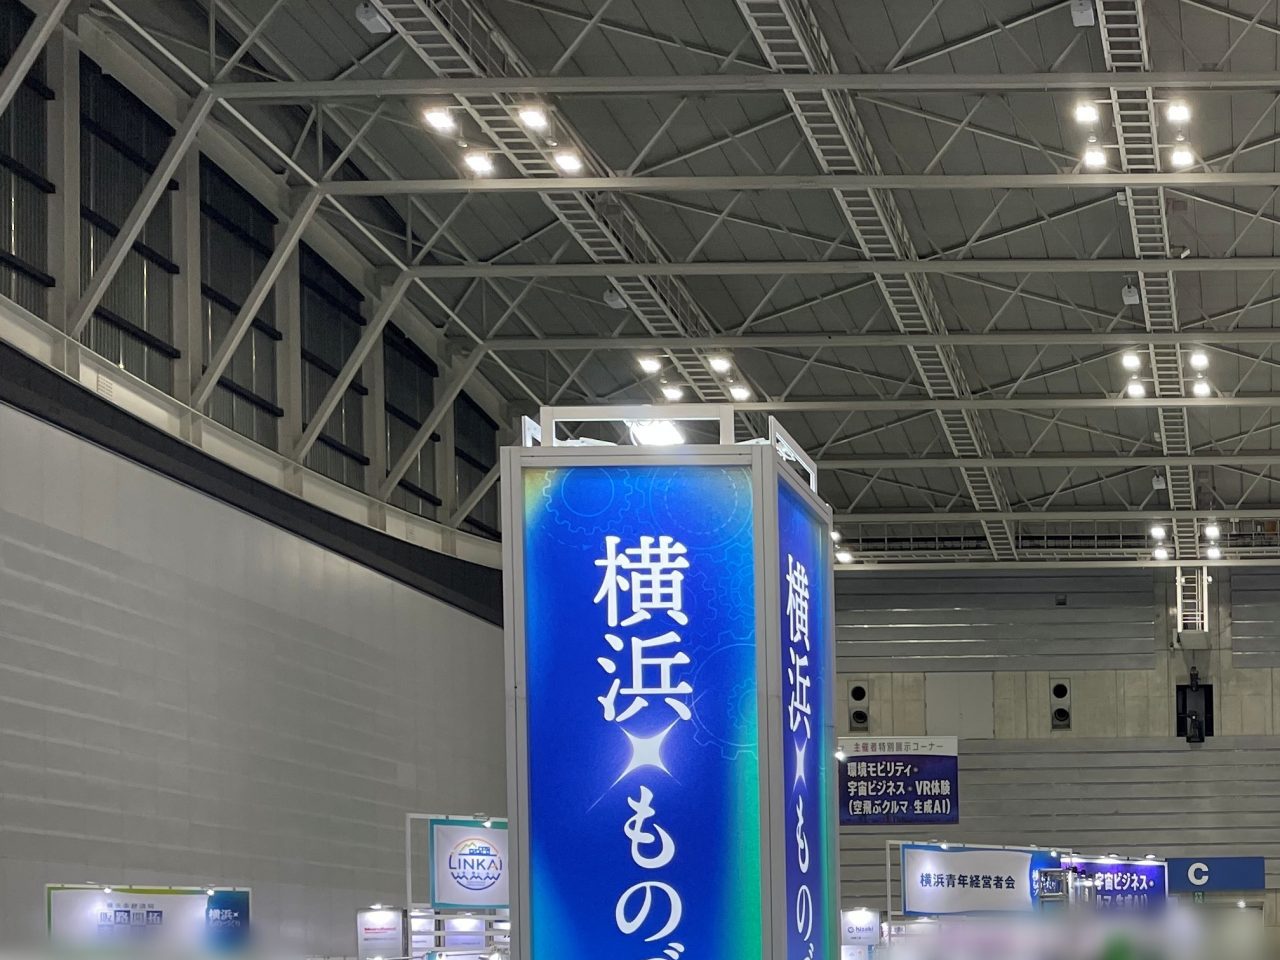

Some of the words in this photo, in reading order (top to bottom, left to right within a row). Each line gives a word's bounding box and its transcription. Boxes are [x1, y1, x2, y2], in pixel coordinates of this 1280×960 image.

[920, 873, 1016, 890] 横浜青年経営者会
[1187, 862, 1209, 886] C
